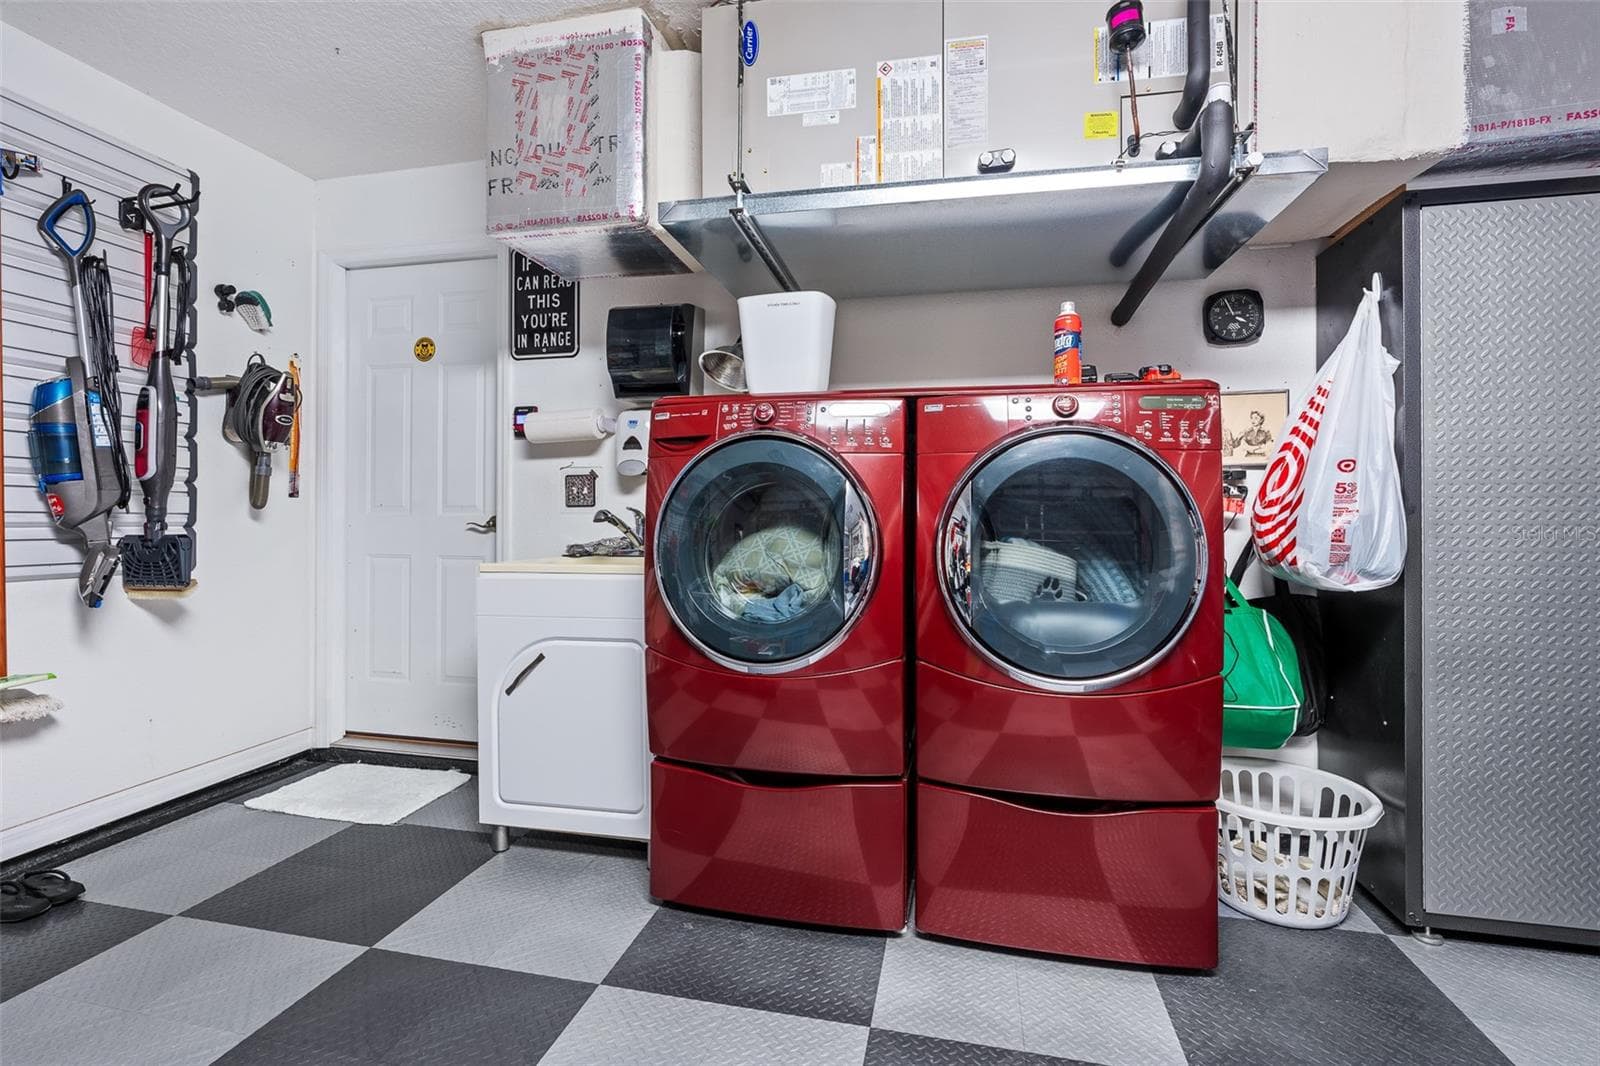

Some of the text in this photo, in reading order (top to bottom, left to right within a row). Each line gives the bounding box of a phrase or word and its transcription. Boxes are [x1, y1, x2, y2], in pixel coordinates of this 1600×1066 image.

[745, 26, 753, 60] Carrier
[1566, 109, 1600, 120] FASS
[522, 257, 532, 272] IF
[516, 275, 539, 291] CAN
[528, 293, 560, 309] THIS
[520, 312, 568, 328] YOU'RE
[518, 331, 572, 348] IN RANGE
